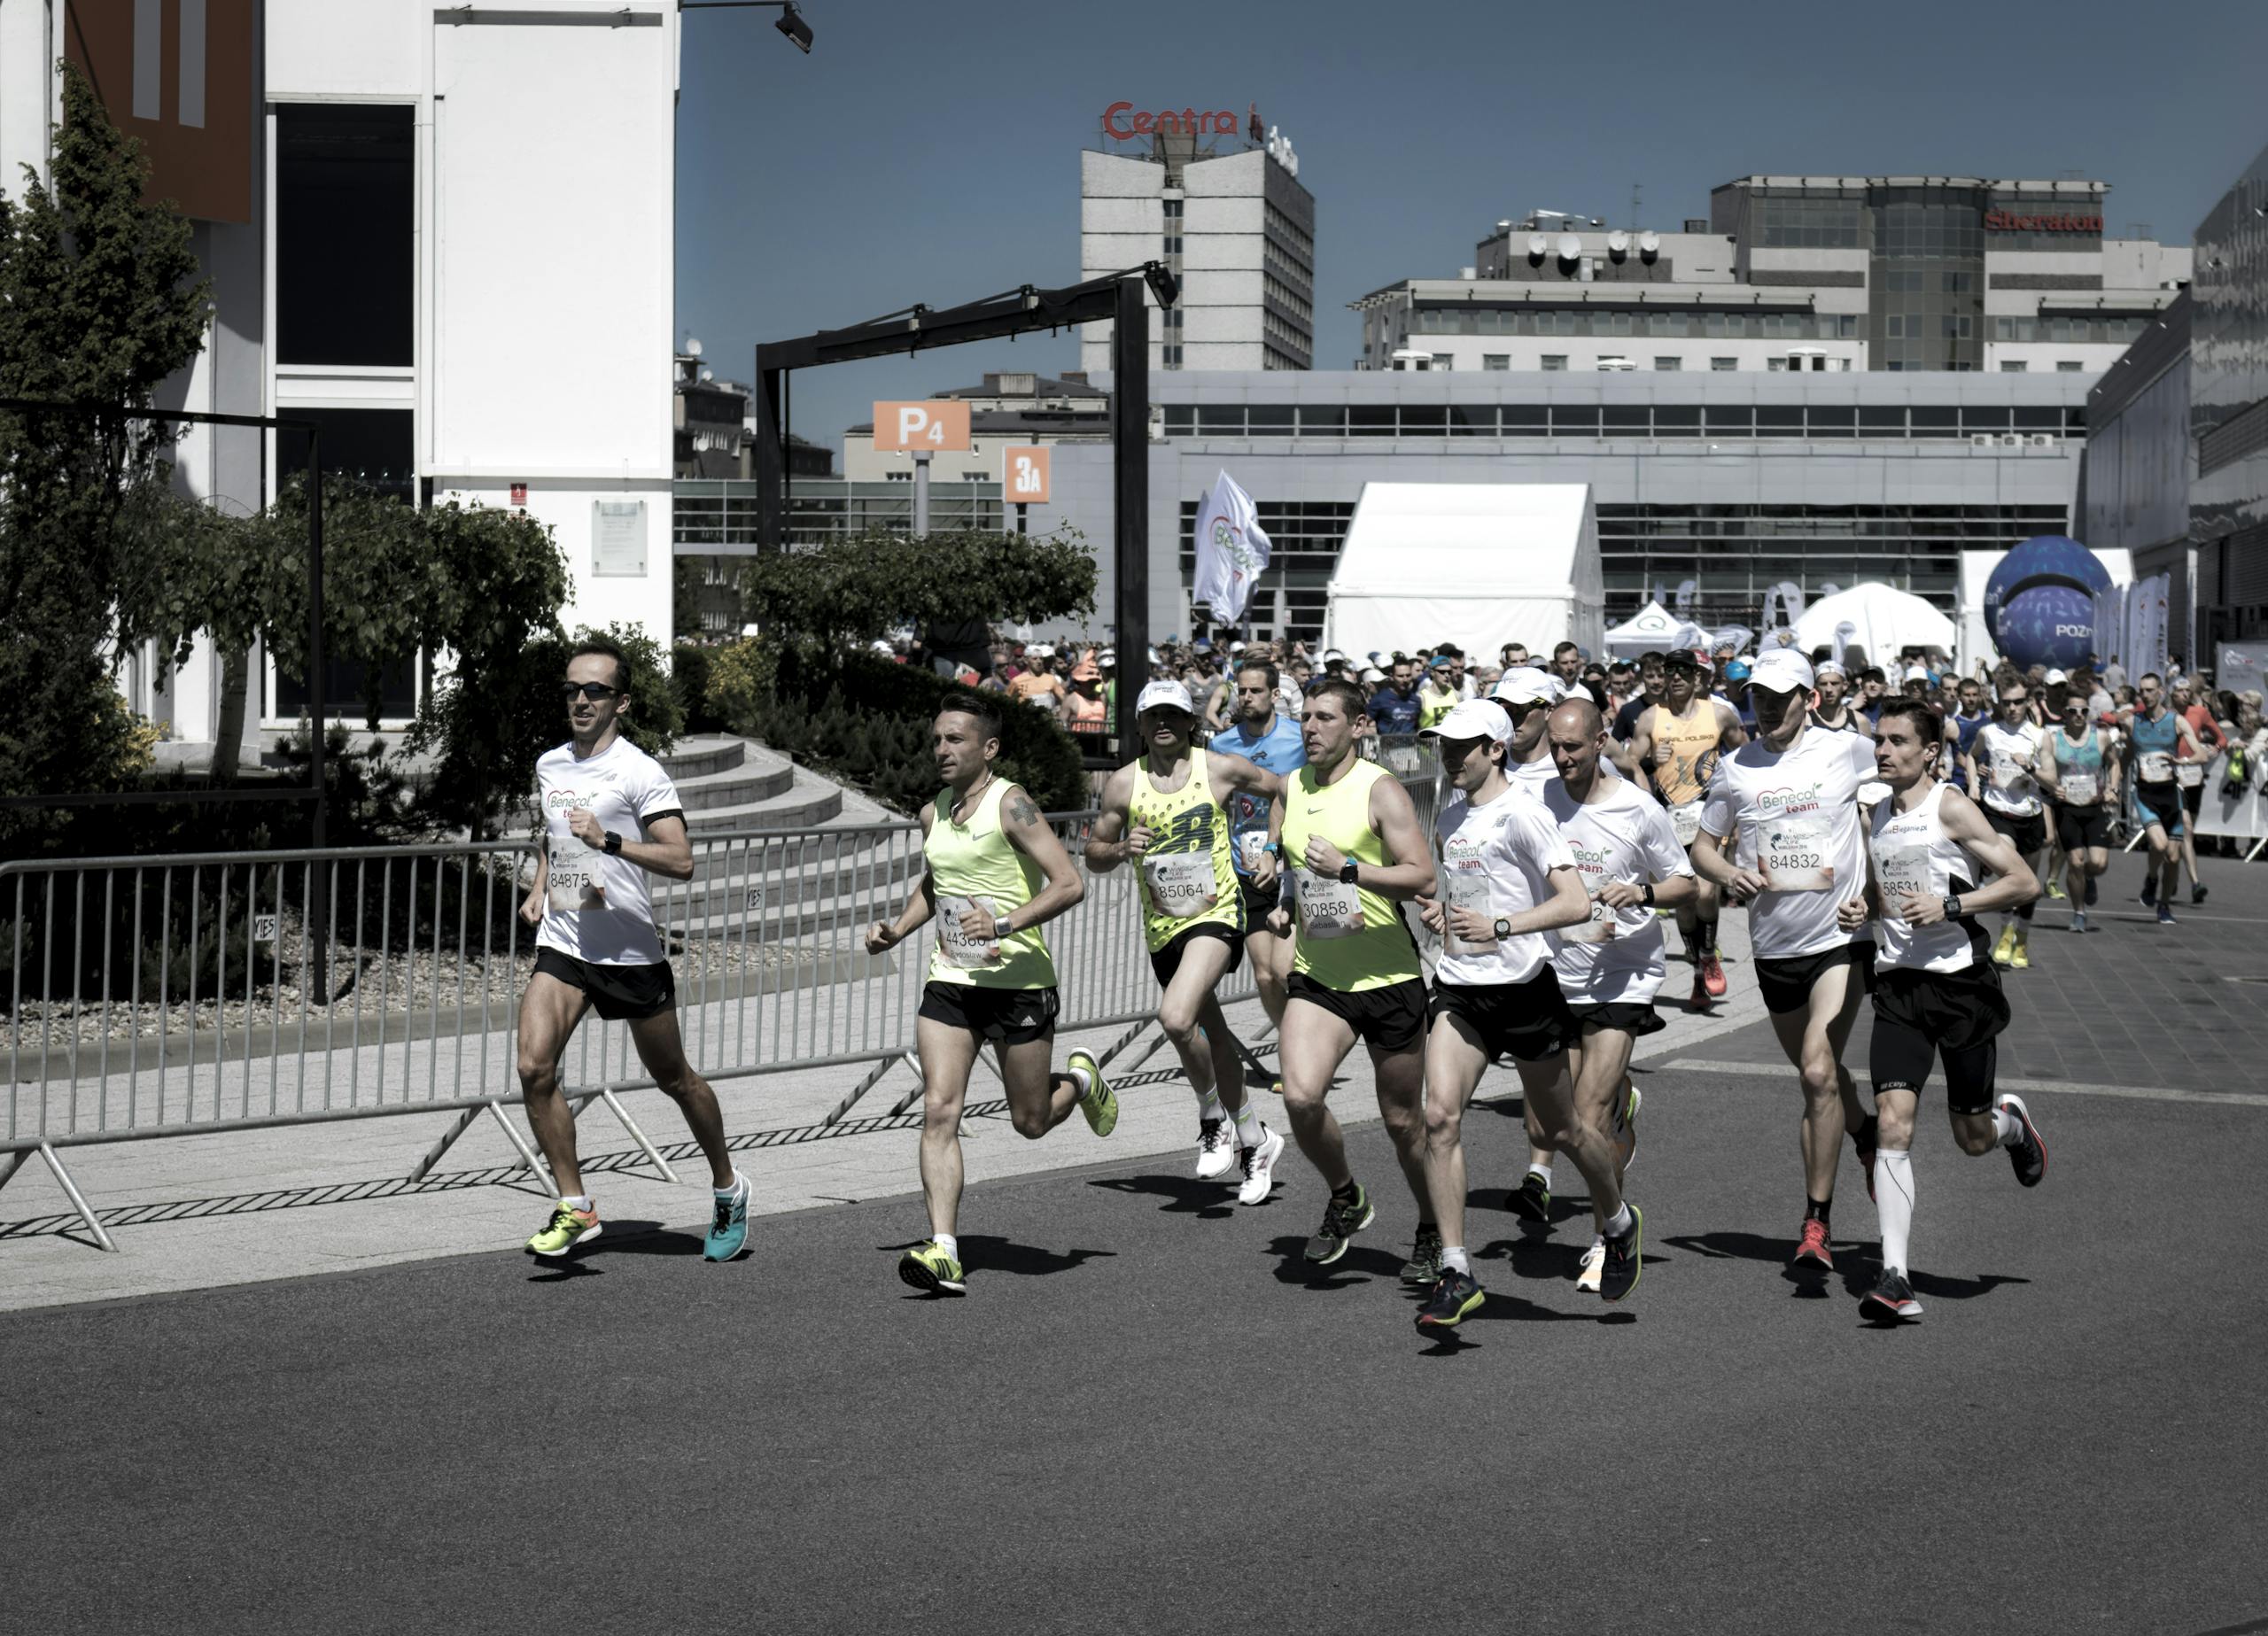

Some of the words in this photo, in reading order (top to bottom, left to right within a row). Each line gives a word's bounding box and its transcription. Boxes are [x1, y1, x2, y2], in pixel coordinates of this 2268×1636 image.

[1104, 101, 1238, 140] Centra
[1985, 208, 2104, 231] Sheraton
[1762, 787, 1817, 810] Benecol
[1785, 802, 1820, 814] team
[1449, 843, 1480, 859] Benecol
[1458, 859, 1480, 870] team
[1576, 863, 1604, 874] eam
[1770, 853, 1821, 870] 84832
[550, 872, 590, 888] 84875
[1159, 883, 1205, 899] 85064
[1303, 901, 1348, 918] 30858
